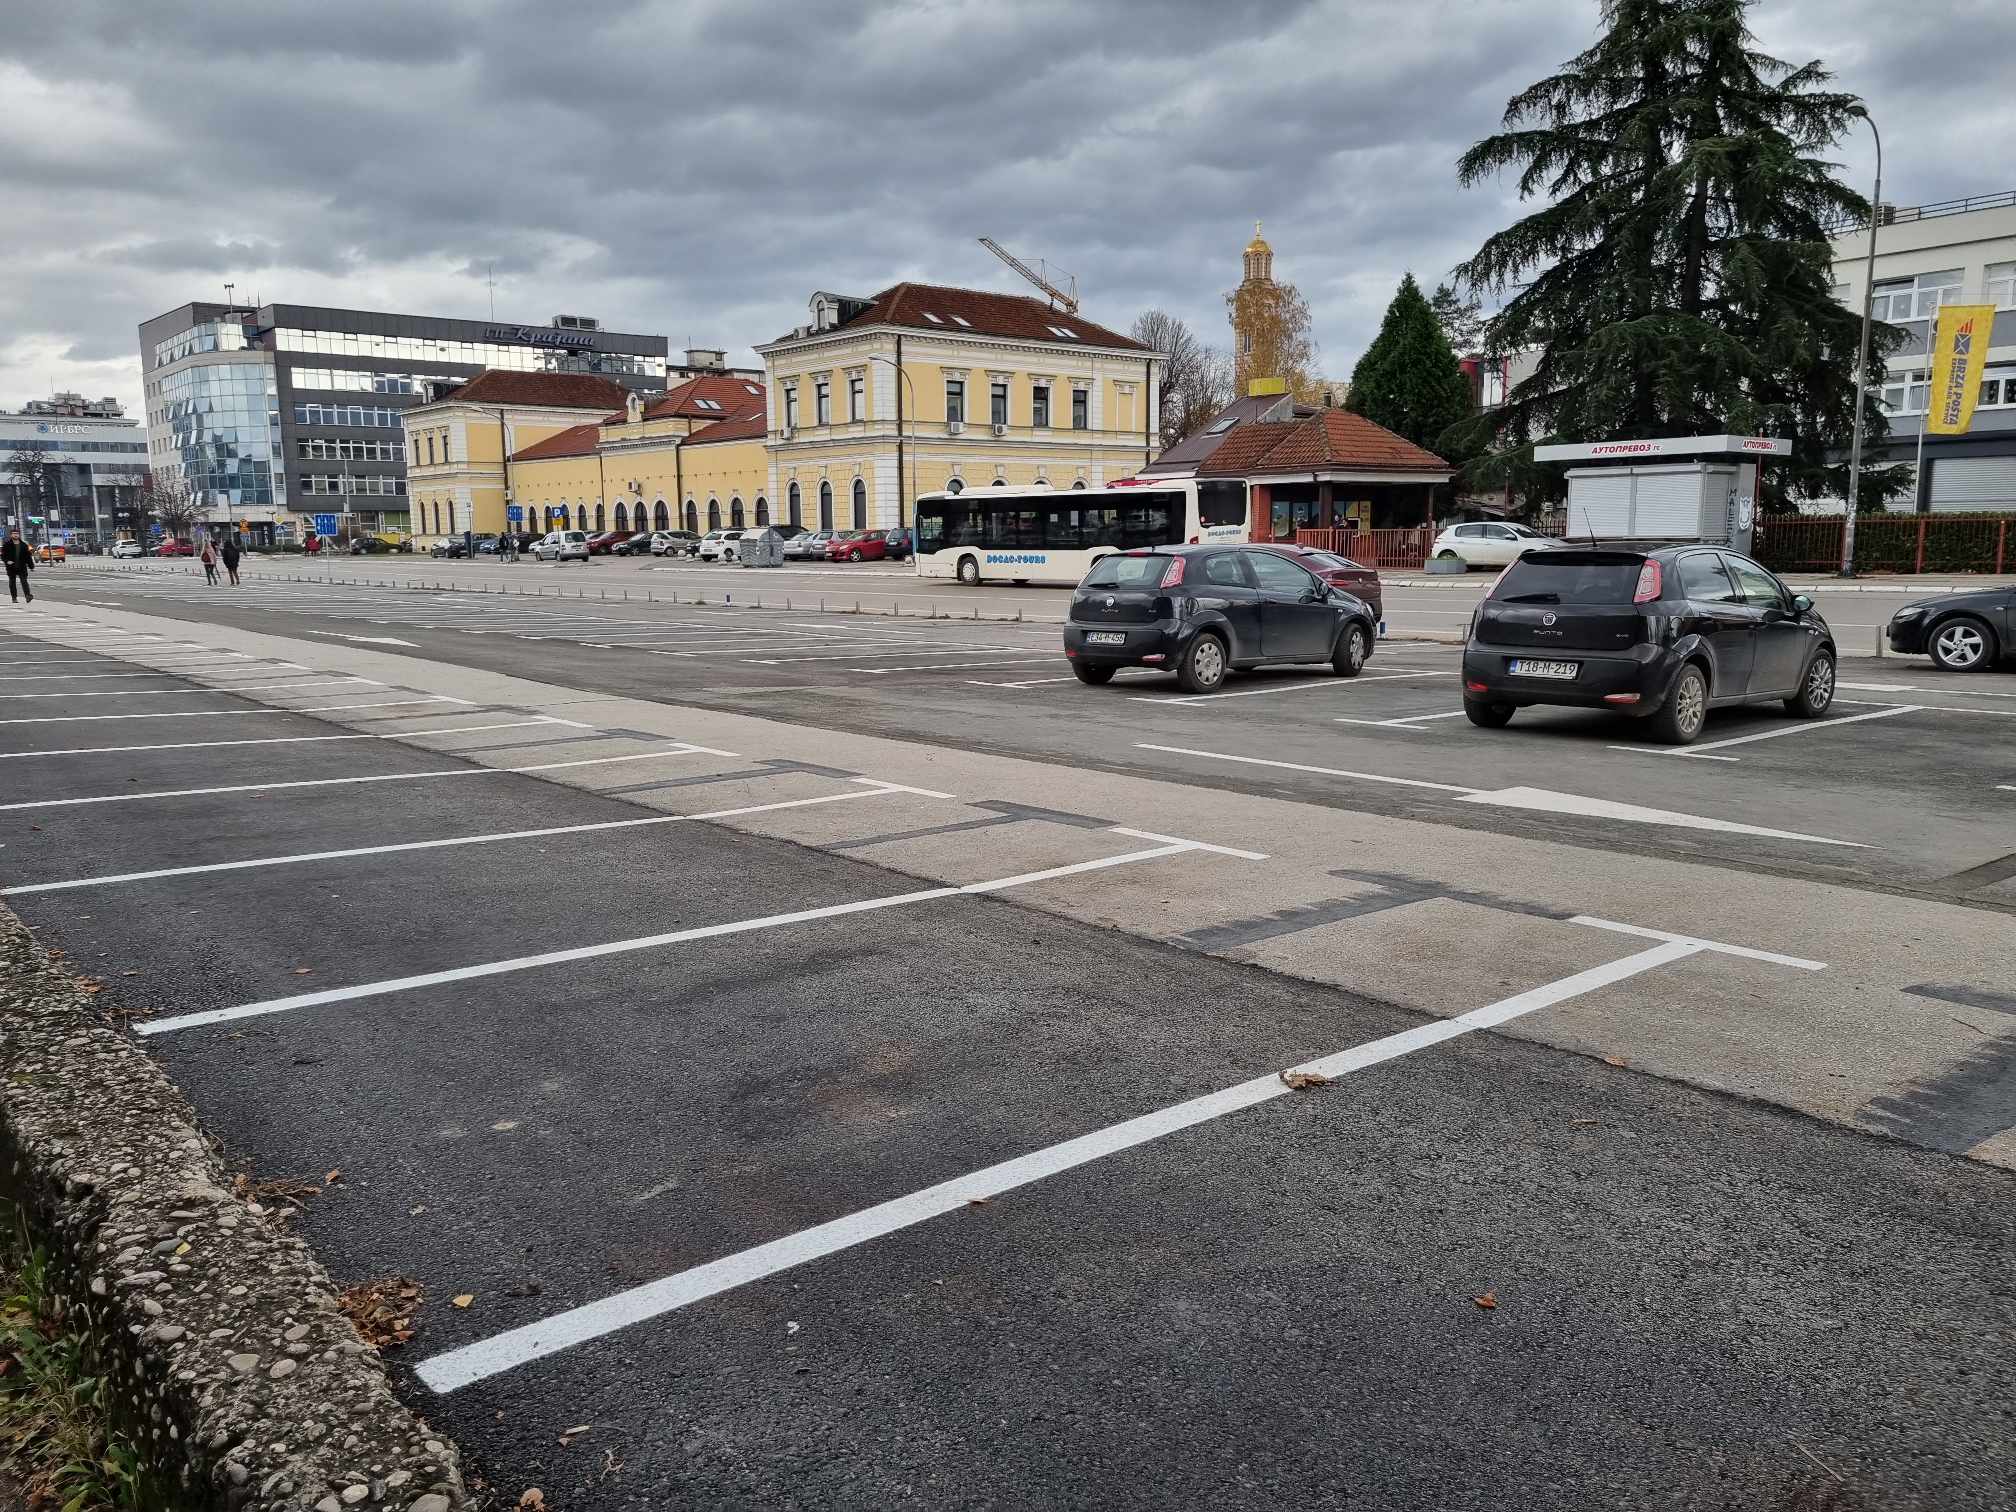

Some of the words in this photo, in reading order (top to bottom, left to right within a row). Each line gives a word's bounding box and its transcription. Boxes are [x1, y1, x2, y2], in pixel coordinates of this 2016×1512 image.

[1954, 358, 1967, 388] BRZA
[1949, 391, 1962, 425] POŠTA
[1591, 443, 1652, 455] АУТОПРЕВОЗ
